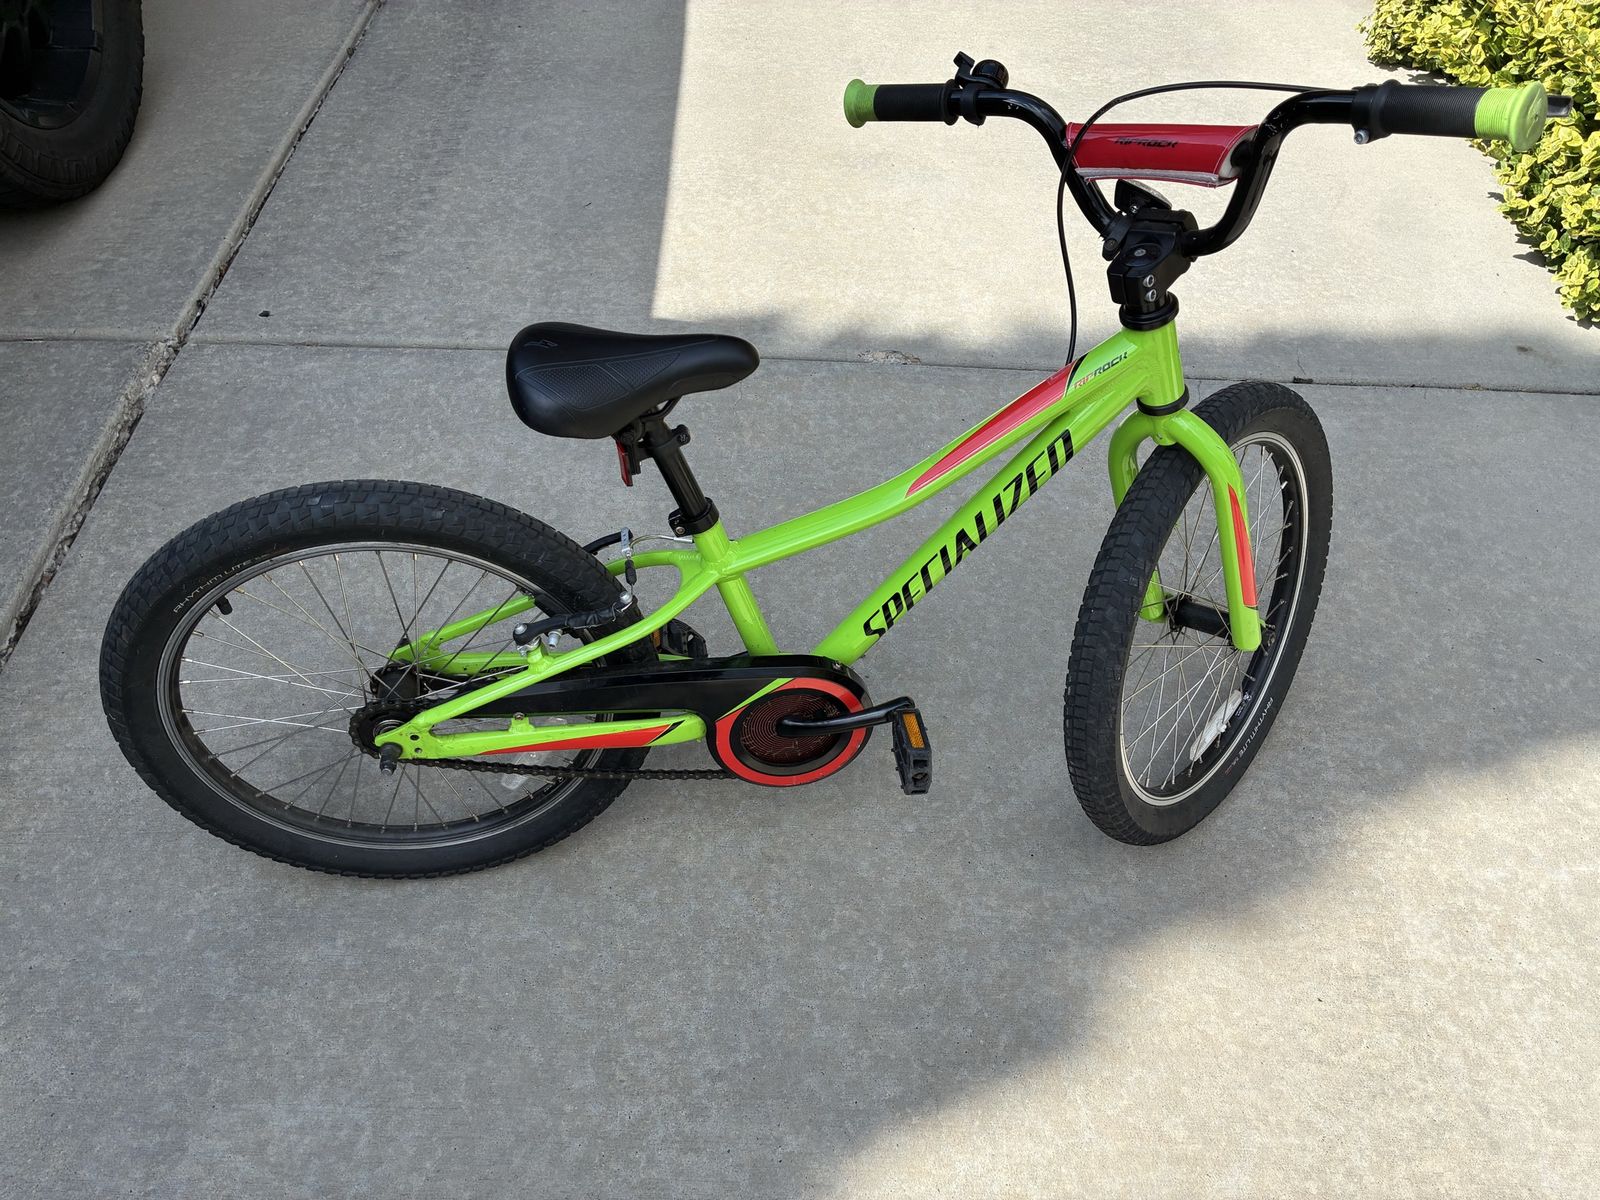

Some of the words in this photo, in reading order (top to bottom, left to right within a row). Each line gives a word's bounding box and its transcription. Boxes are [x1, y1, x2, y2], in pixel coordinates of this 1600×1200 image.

[1114, 136, 1179, 148] RIPROCK
[1073, 351, 1128, 389] RIPROCK
[862, 429, 1075, 639] SPECIALIZED
[173, 573, 223, 613] RHYTHM
[224, 560, 252, 575] LITE
[1250, 697, 1274, 740] RHYTHM
